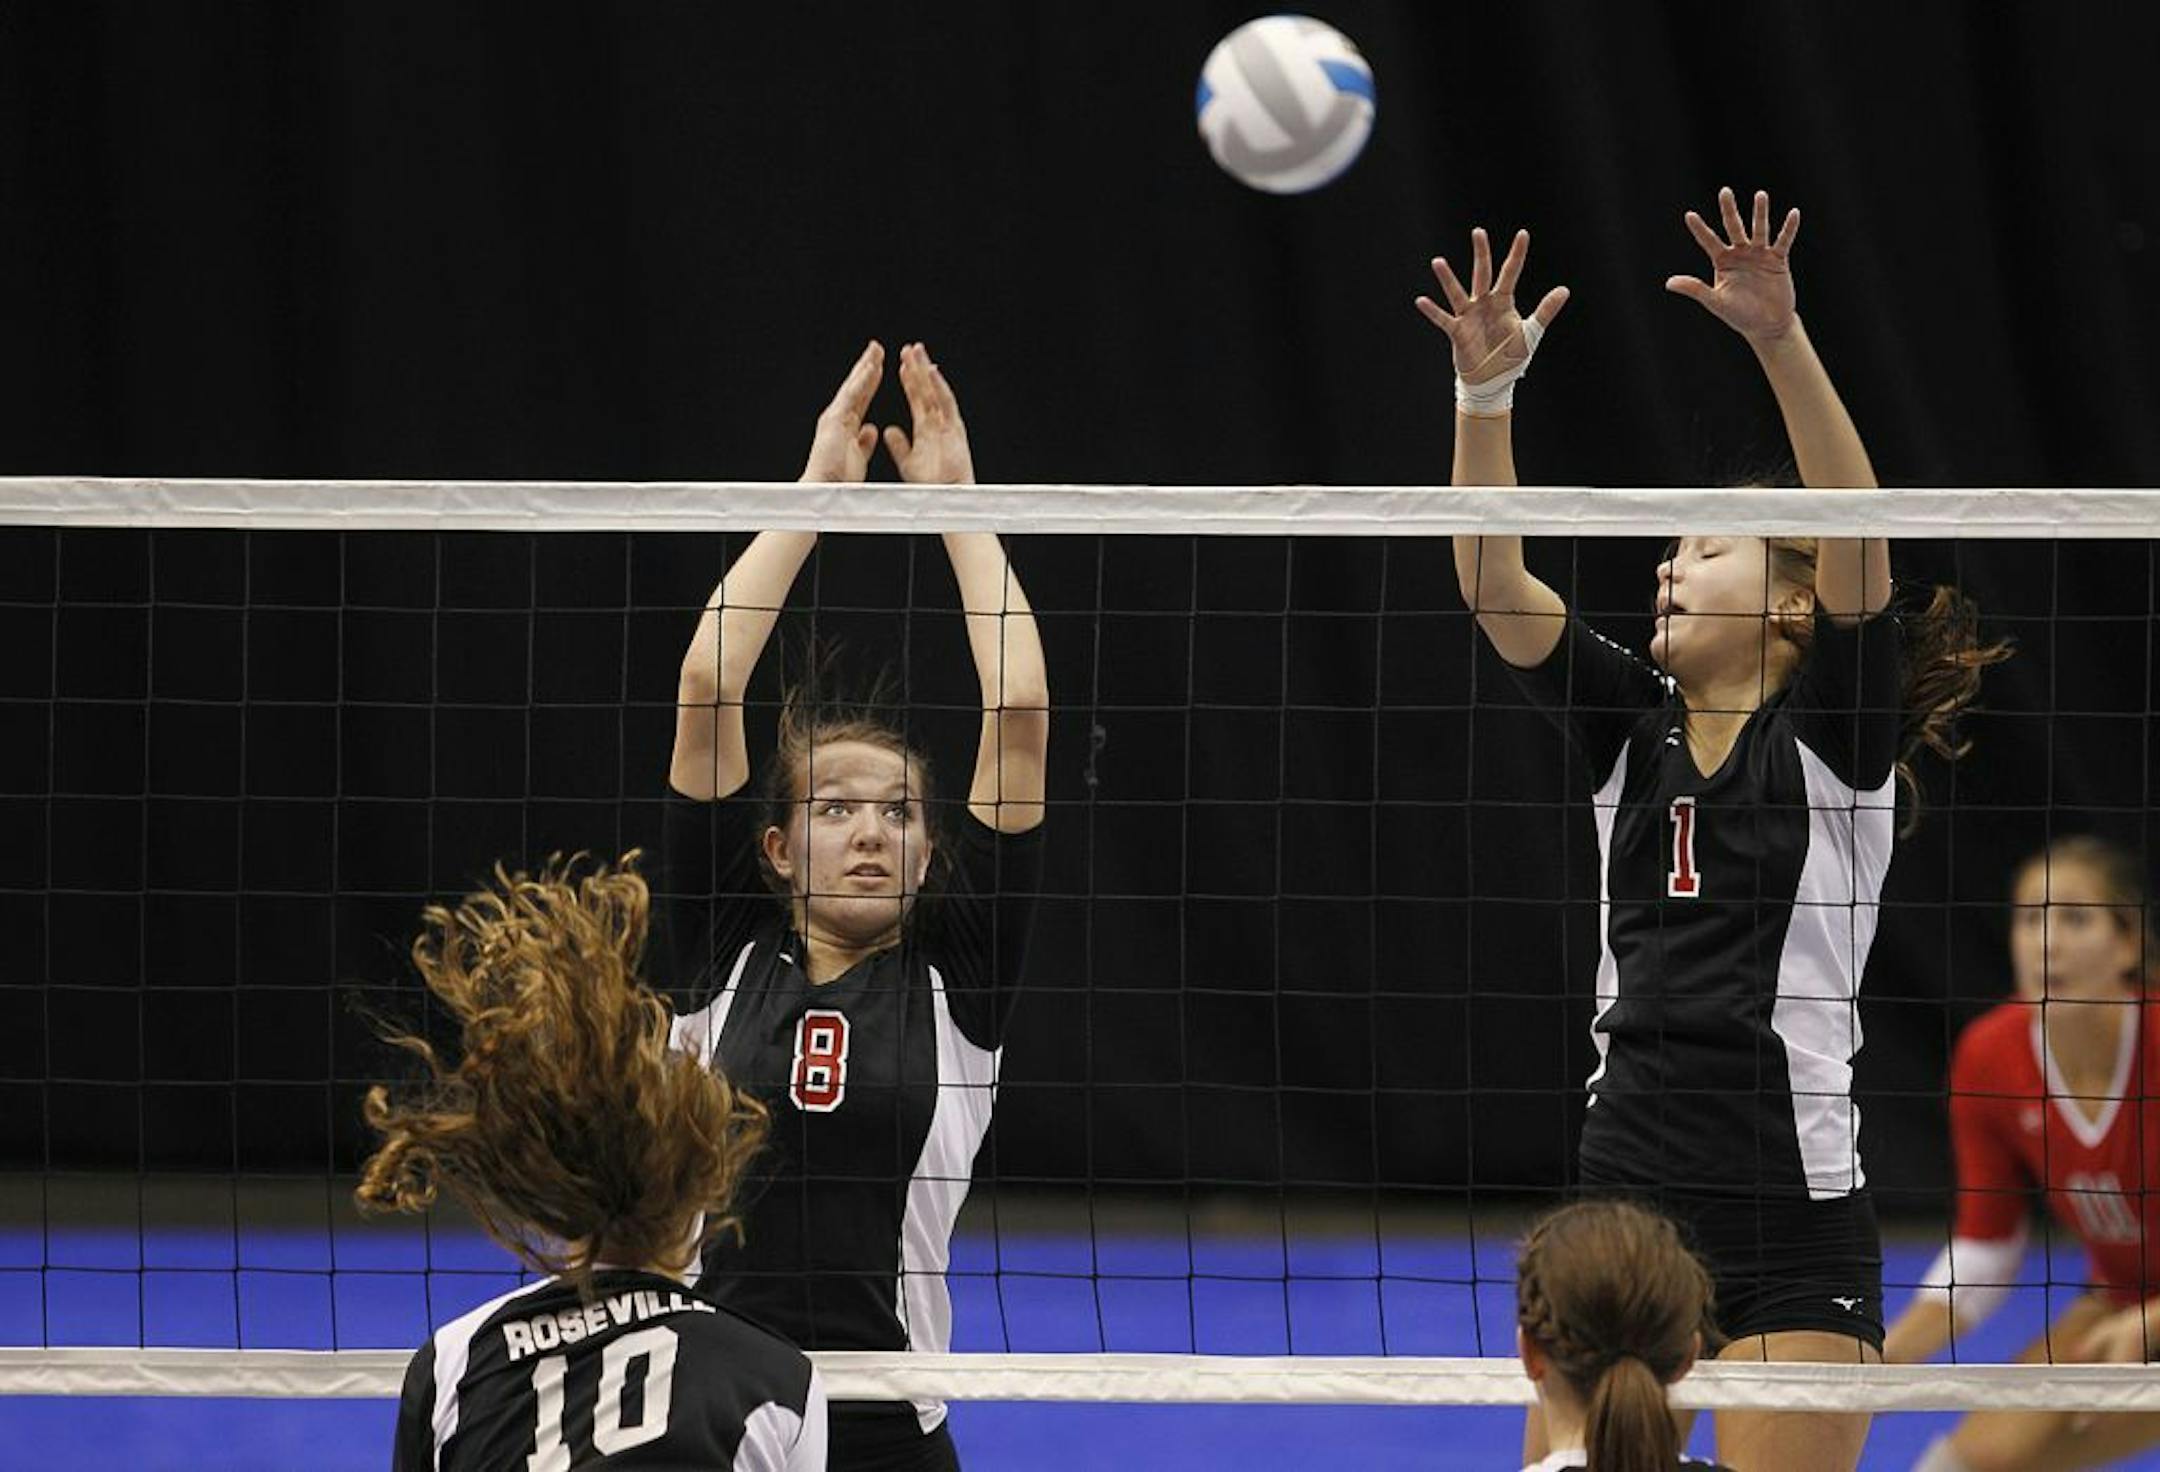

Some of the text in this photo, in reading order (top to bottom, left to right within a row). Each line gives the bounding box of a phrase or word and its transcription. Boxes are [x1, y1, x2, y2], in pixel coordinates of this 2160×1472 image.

[1668, 797, 1700, 897] 1
[790, 1009, 849, 1112] 8
[527, 1325, 679, 1472] 10
